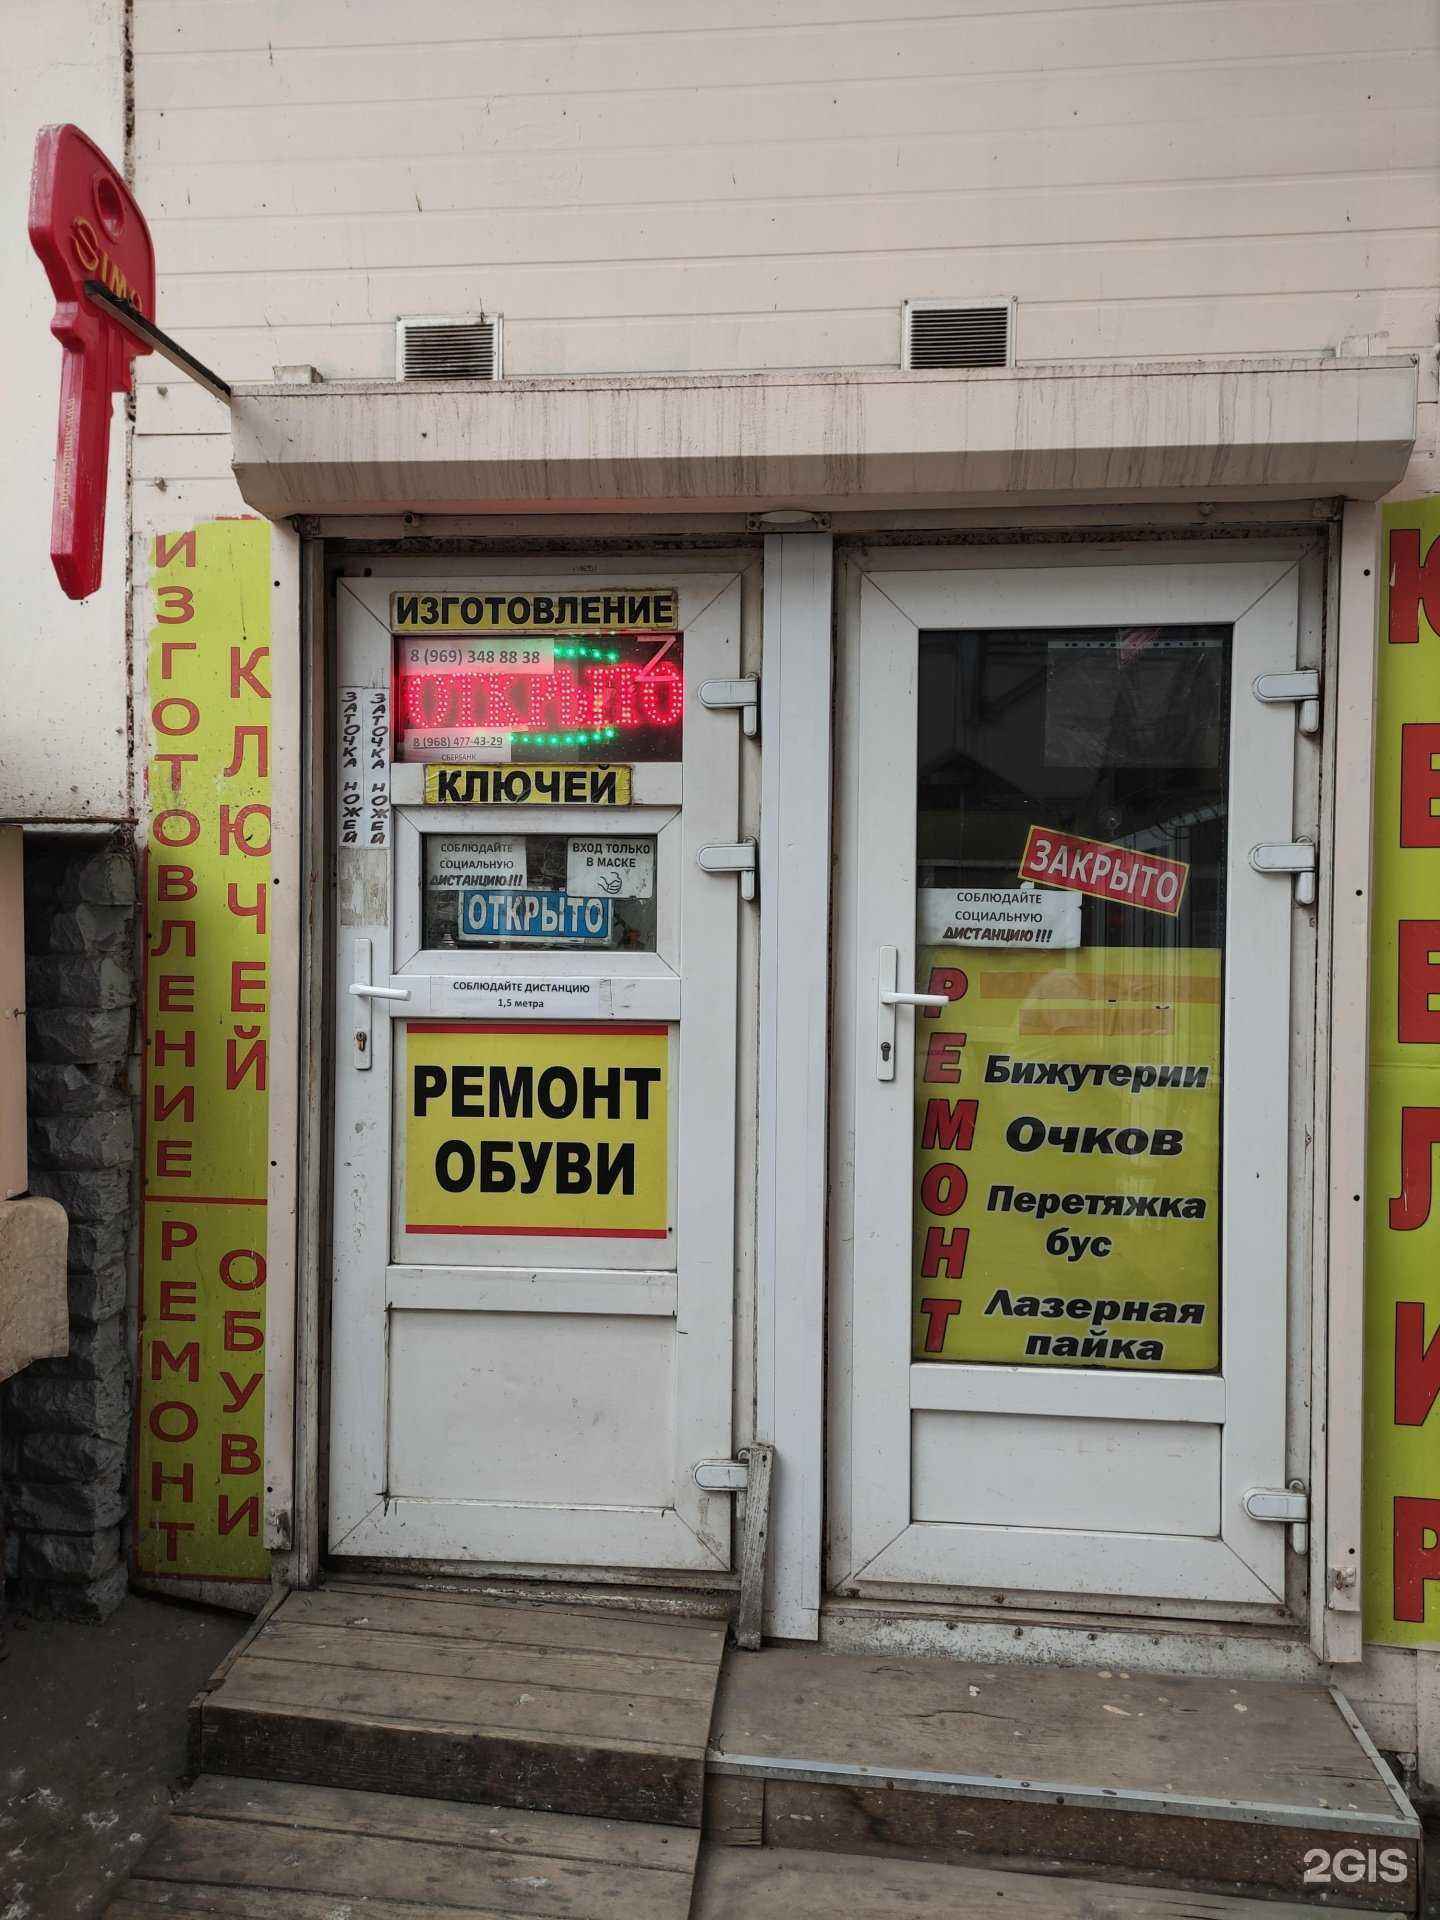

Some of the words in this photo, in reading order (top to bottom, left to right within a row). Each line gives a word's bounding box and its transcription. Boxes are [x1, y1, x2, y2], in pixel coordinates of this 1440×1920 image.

[396, 595, 674, 626] ИЗГОТОВЛЕНИЕ
[410, 648, 420, 662] 8
[424, 647, 463, 666] (969)
[467, 650, 495, 664] 348
[499, 650, 518, 664] 88
[521, 651, 540, 664] 38
[407, 664, 683, 728] ОТКРЫТО
[342, 692, 361, 768] ЗАТОЧКА
[370, 693, 389, 770] ЗАТОЧКА
[423, 736, 450, 747] (968)
[453, 736, 503, 747] 477-43-29
[437, 763, 618, 804] КЛЮЧЕЙ
[150, 530, 201, 1178] ИЗГОТОВЛЕНИЕ
[439, 859, 514, 870] СОЦИАЛЬНУЮ
[440, 841, 513, 854] СОБЛЮДАЙТЕ
[572, 843, 602, 855] ВХОД
[606, 843, 650, 855] ТОЛЬКО
[586, 858, 594, 868] В
[597, 857, 636, 868] МАСКЕ
[219, 646, 272, 1091] КЛЮЧЕЙ
[1029, 839, 1179, 903] ЗАКРЫТО
[468, 894, 605, 934] ОТКРЫТО
[956, 891, 1043, 905] СОБЛЮДАЙТЕ
[955, 910, 1043, 924] СОЦИАЛЬНУЮ
[453, 980, 523, 992] СОБЛЮДАЙТЕ
[525, 982, 590, 995] ДИСТАНЦИЮ
[498, 998, 512, 1010] 1,5
[514, 999, 544, 1010] метра
[414, 1065, 661, 1120] РЕМОНТ
[983, 1055, 1210, 1093] Бижутерии
[1005, 1115, 1184, 1156] Очков
[435, 1139, 635, 1196] ОБУВИ
[919, 966, 979, 1353] РЕМОНТ
[986, 1185, 1208, 1220] Перетяжка
[1045, 1227, 1112, 1262] бус
[984, 1289, 1206, 1325] Лазерная
[1024, 1330, 1165, 1361] пайка
[148, 1220, 199, 1563] РЕМОНТ
[217, 1249, 268, 1538] ОБУВИ
